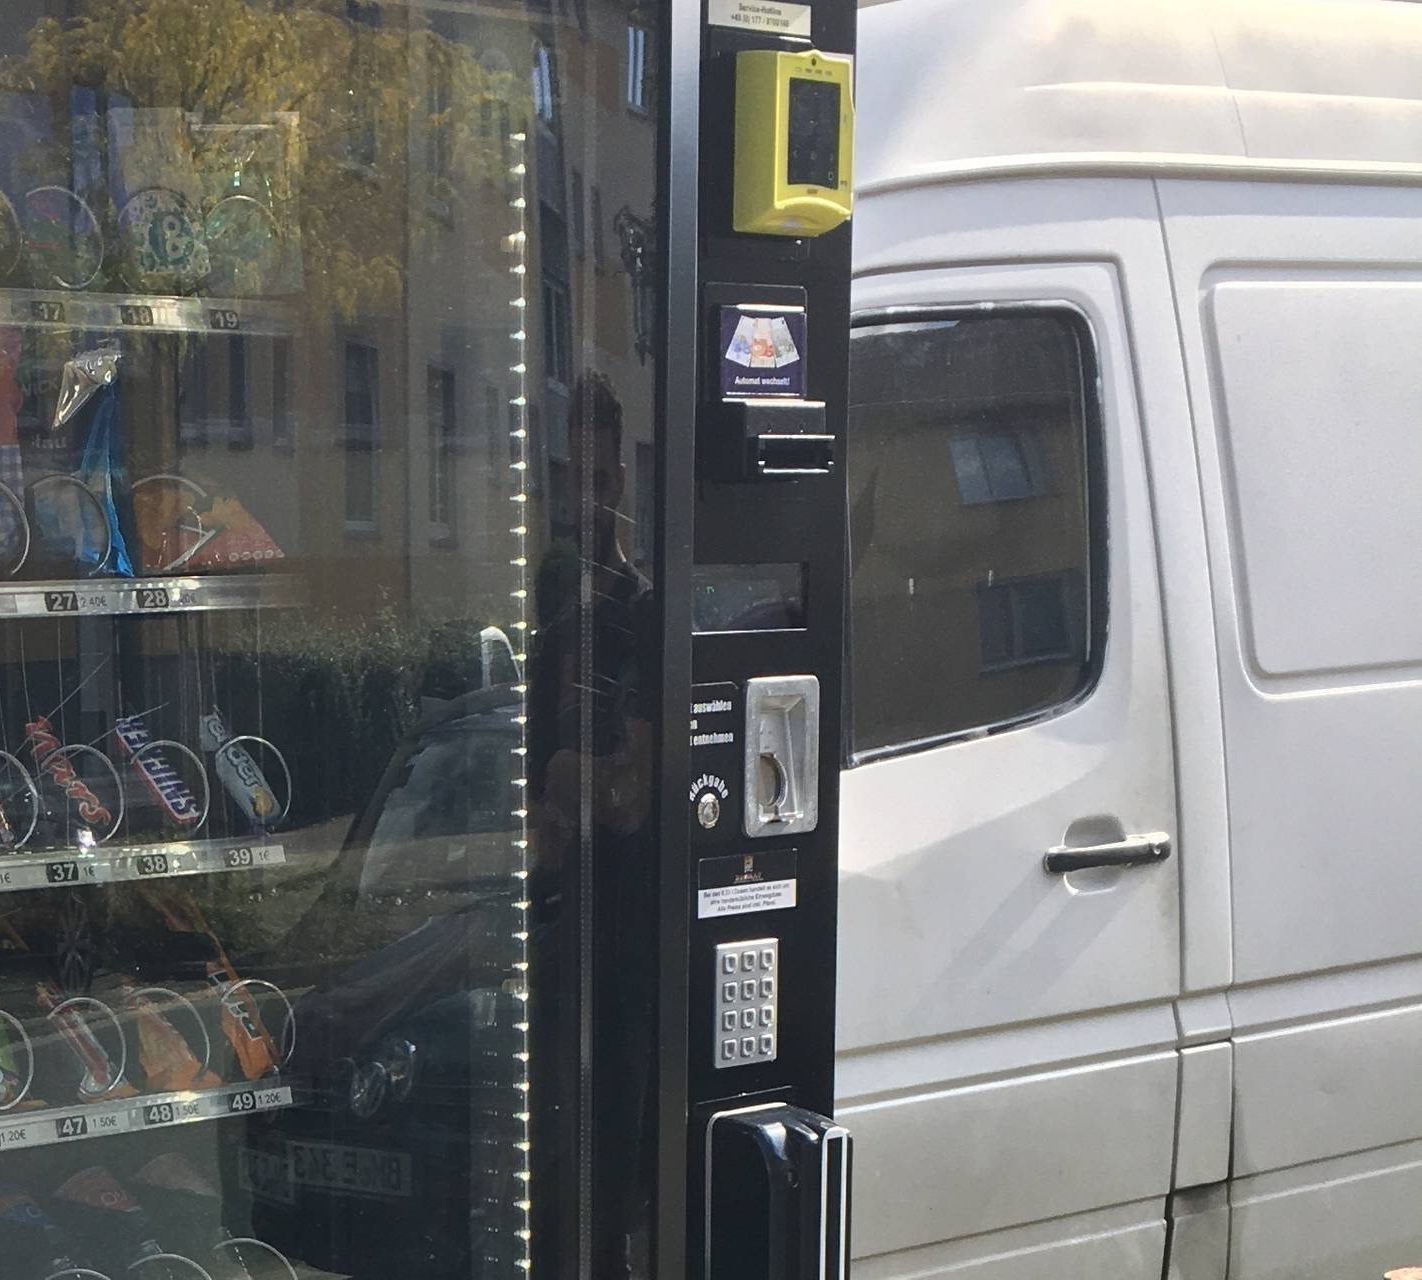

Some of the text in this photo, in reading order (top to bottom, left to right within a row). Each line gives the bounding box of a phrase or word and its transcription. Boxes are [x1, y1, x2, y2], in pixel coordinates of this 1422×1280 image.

[40, 302, 62, 321] 17
[129, 306, 152, 325] 18
[216, 311, 238, 329] 19
[51, 592, 75, 611] 27
[144, 589, 168, 607] 28
[693, 700, 732, 714] auswählen
[693, 732, 734, 746] entnehmen
[25, 716, 112, 825] Mars
[143, 855, 167, 873] 38
[228, 848, 250, 866] 39
[53, 864, 96, 881] 37 1€
[231, 1092, 282, 1110] 49 1.20€
[148, 1104, 172, 1122] 48
[62, 1115, 117, 1135] 47 1.50€
[1, 1130, 27, 1143] 1.20€
